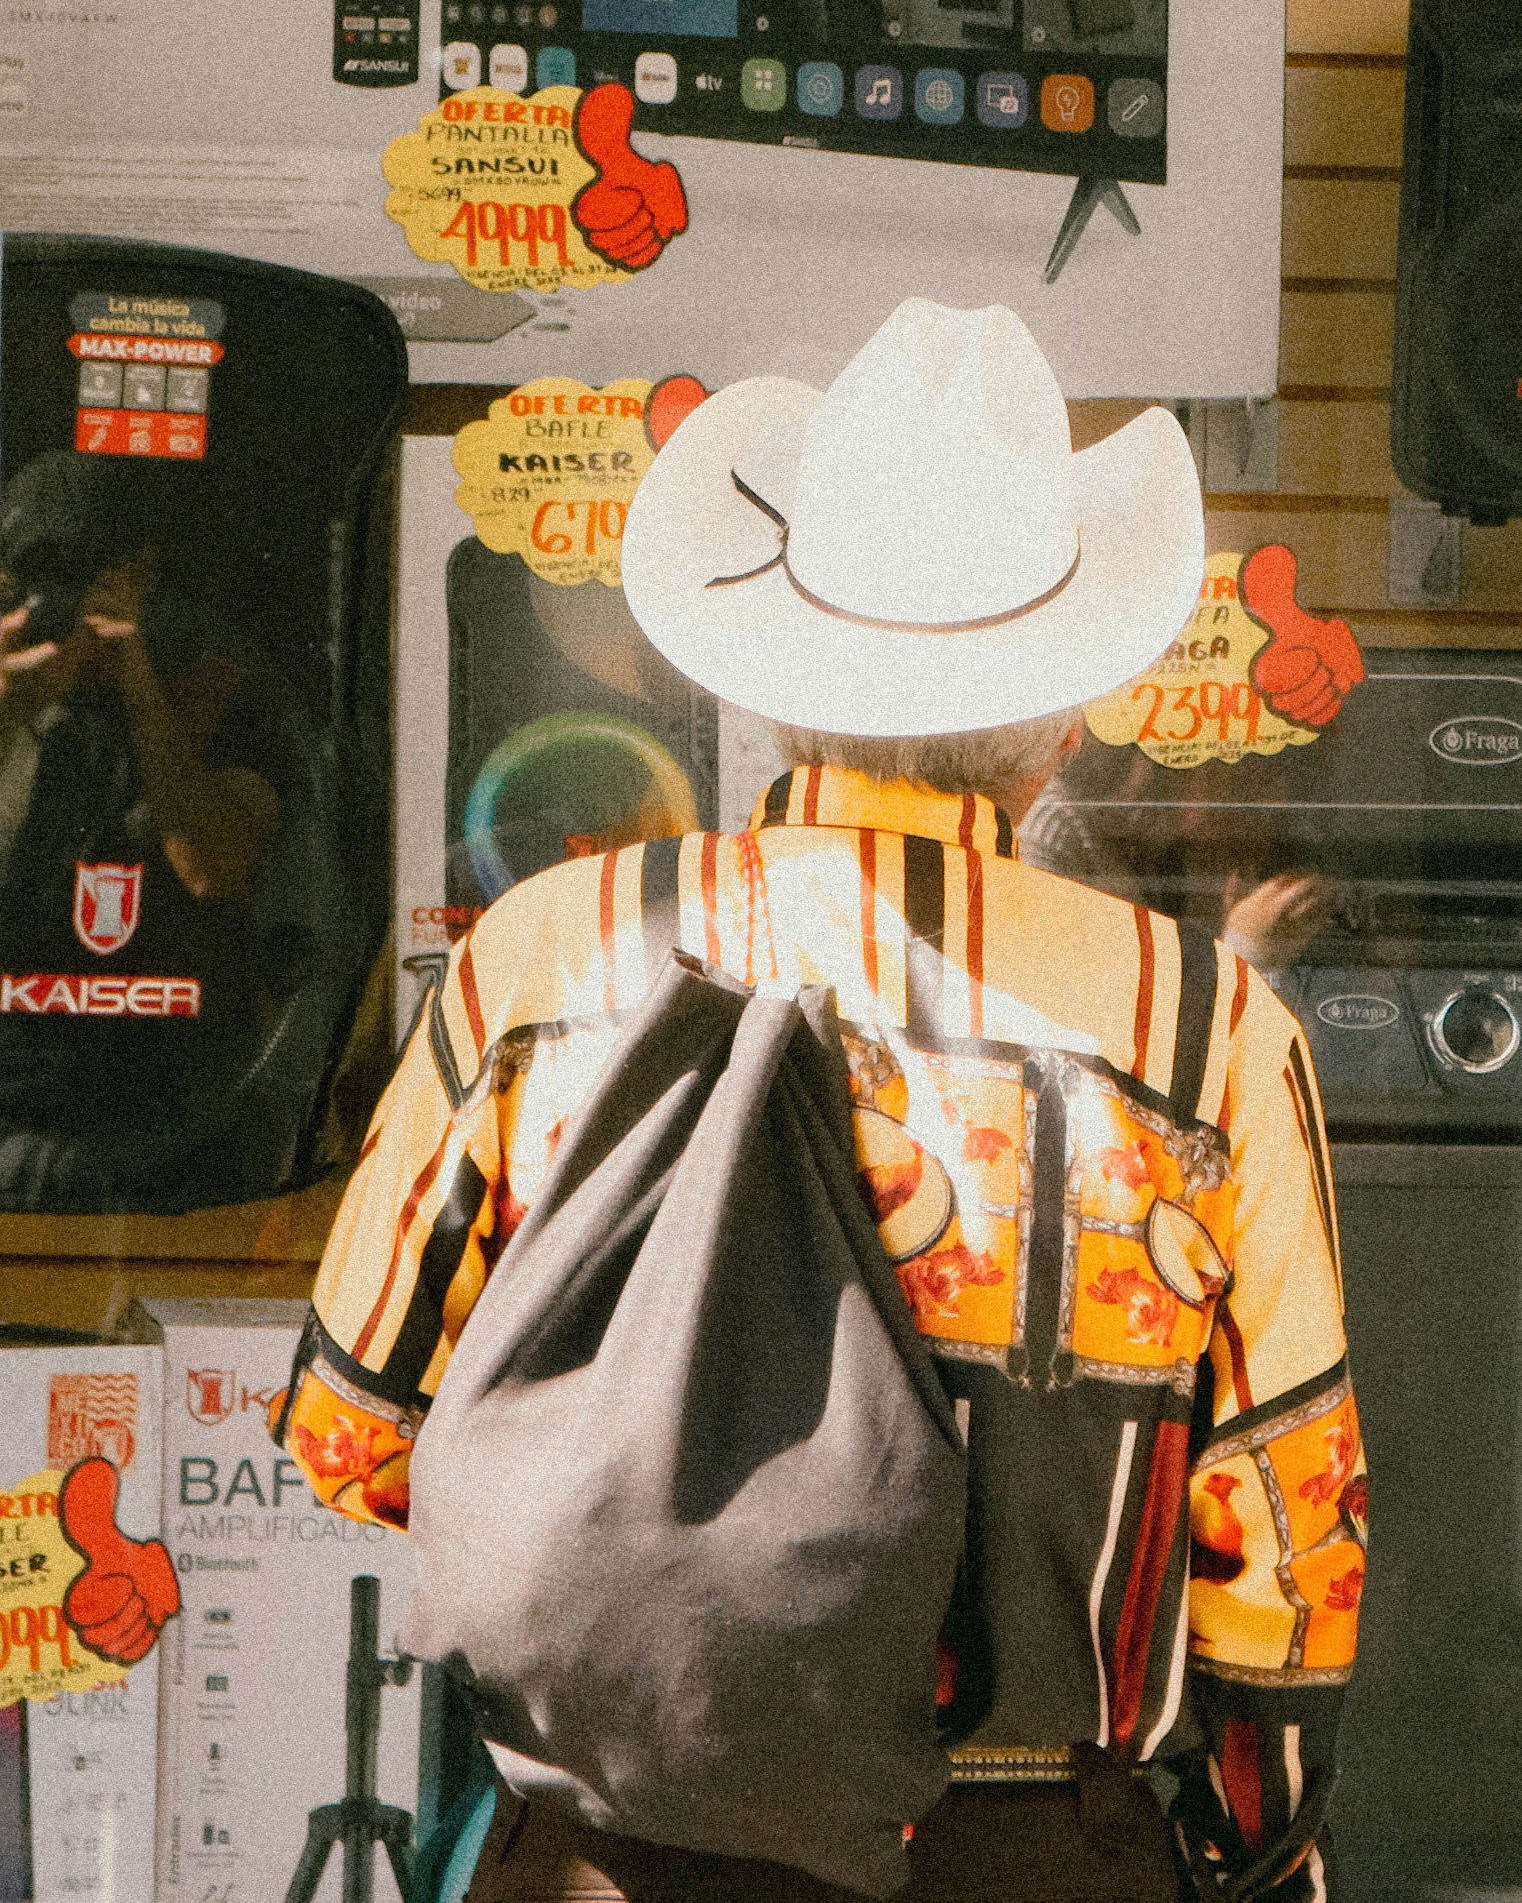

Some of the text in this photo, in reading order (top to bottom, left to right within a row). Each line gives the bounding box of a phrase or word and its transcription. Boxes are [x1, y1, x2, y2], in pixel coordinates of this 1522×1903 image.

[442, 99, 573, 130] OFERTA
[426, 122, 569, 147] PANTALLA
[431, 156, 559, 176] SANSUI
[439, 199, 575, 267] 4999
[79, 337, 213, 364] MAX-POWER
[509, 394, 644, 420] OFERTA
[525, 418, 612, 440] BAFLE
[499, 452, 637, 474] KAISER
[1130, 680, 1265, 743] 2399
[1464, 730, 1521, 753] Fraga
[2, 977, 200, 1016] KAISER
[1344, 1004, 1388, 1021] Fraga
